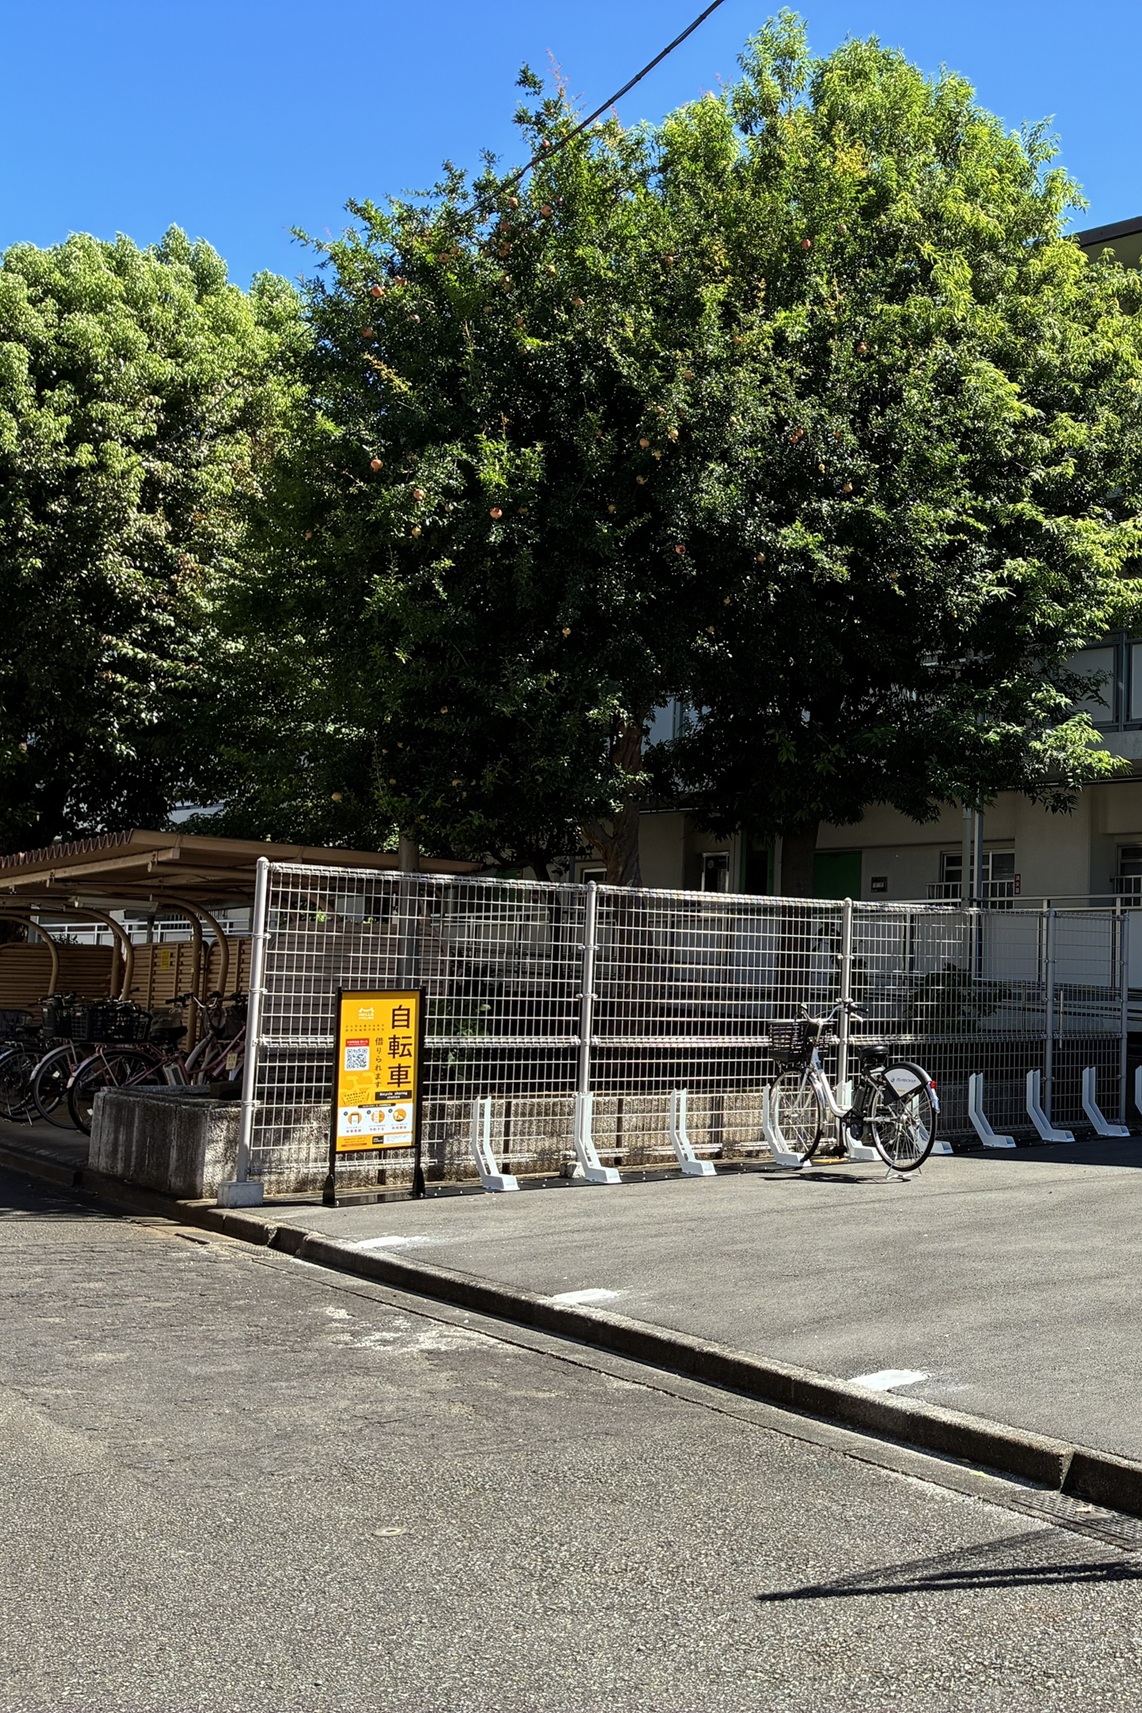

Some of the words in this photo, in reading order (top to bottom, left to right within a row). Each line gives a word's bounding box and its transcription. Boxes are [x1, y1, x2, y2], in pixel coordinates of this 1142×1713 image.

[375, 1037, 383, 1088] 借りられます
[387, 1004, 413, 1088] 自転車
